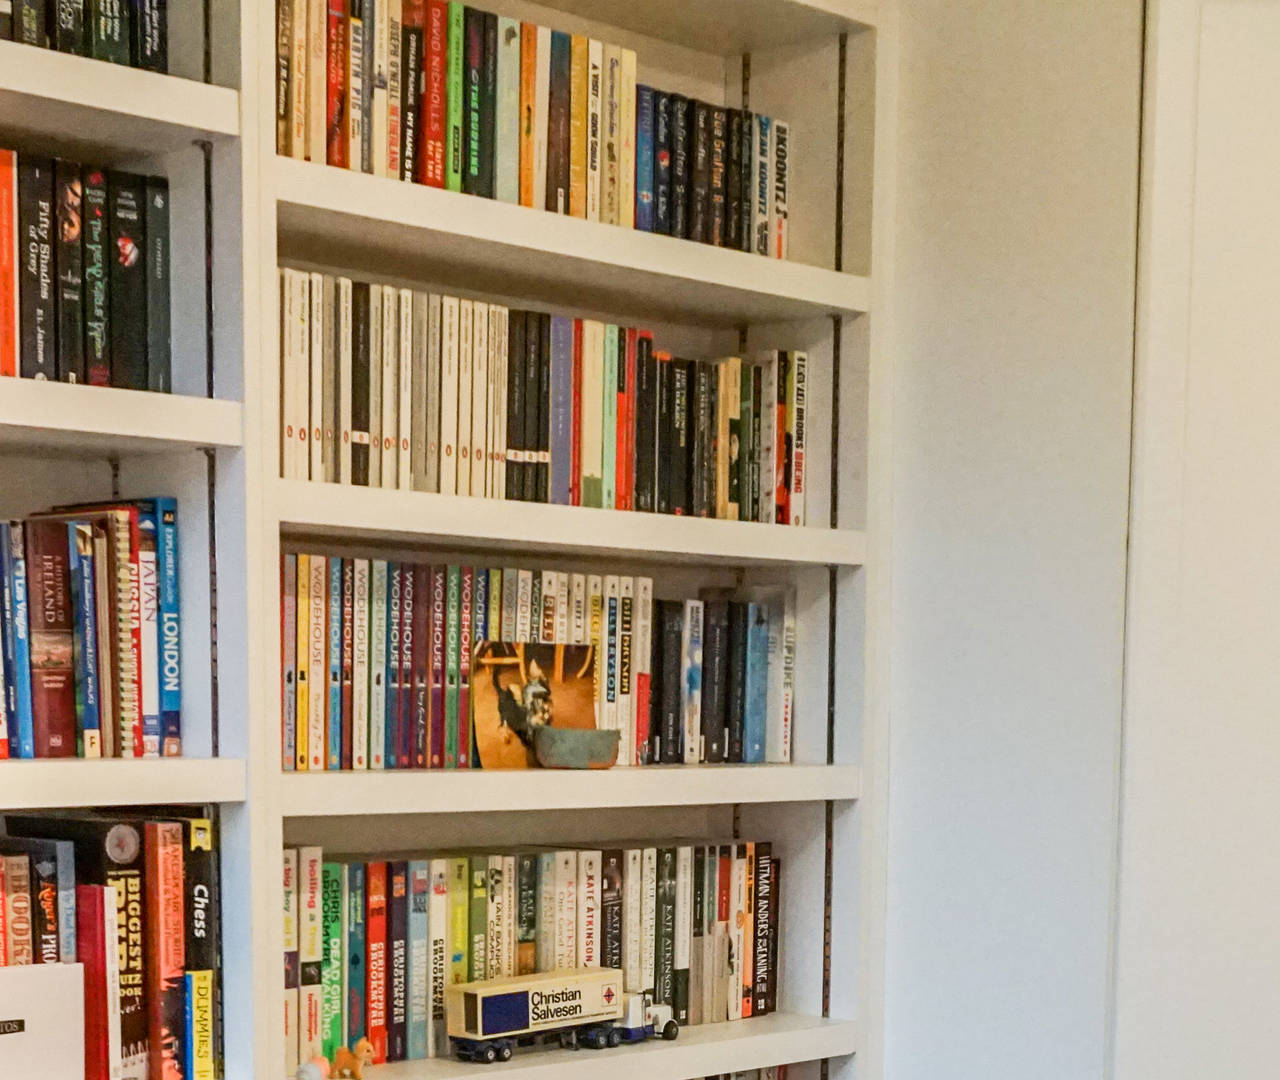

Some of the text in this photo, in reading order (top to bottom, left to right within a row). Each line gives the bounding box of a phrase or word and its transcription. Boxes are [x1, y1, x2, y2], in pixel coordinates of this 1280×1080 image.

[431, 8, 441, 51] DAVID
[431, 56, 441, 132] NICHOLLS
[27, 225, 37, 276] of Grey
[38, 201, 51, 300] Fifty Shades
[35, 323, 44, 363] James
[15, 602, 26, 640] Vegas
[44, 554, 55, 623] IRELAND
[141, 557, 156, 623] JAPAN
[313, 565, 322, 666] WODEHOUSE
[343, 565, 353, 667] WODEHOUSE
[357, 568, 367, 667] WODEHOUSE
[390, 570, 401, 669] WODEHOUSE
[403, 571, 413, 670] WODEHOUSE
[433, 572, 444, 670] WODEHOUSE
[447, 574, 458, 670] WODEHOUSE
[461, 574, 471, 670] WODEHOUSE
[163, 612, 179, 691] LONDON
[127, 877, 142, 970] BIGGEST
[192, 884, 208, 938] Chess
[330, 879, 340, 923] CHRIS
[587, 907, 595, 963] ATKINSON
[330, 937, 340, 1019] DEAD GIRL
[531, 988, 581, 1006] Christian
[664, 938, 672, 998] ATKINSON
[196, 985, 210, 1058] DUMMIES
[532, 1003, 582, 1021] Salvesen
